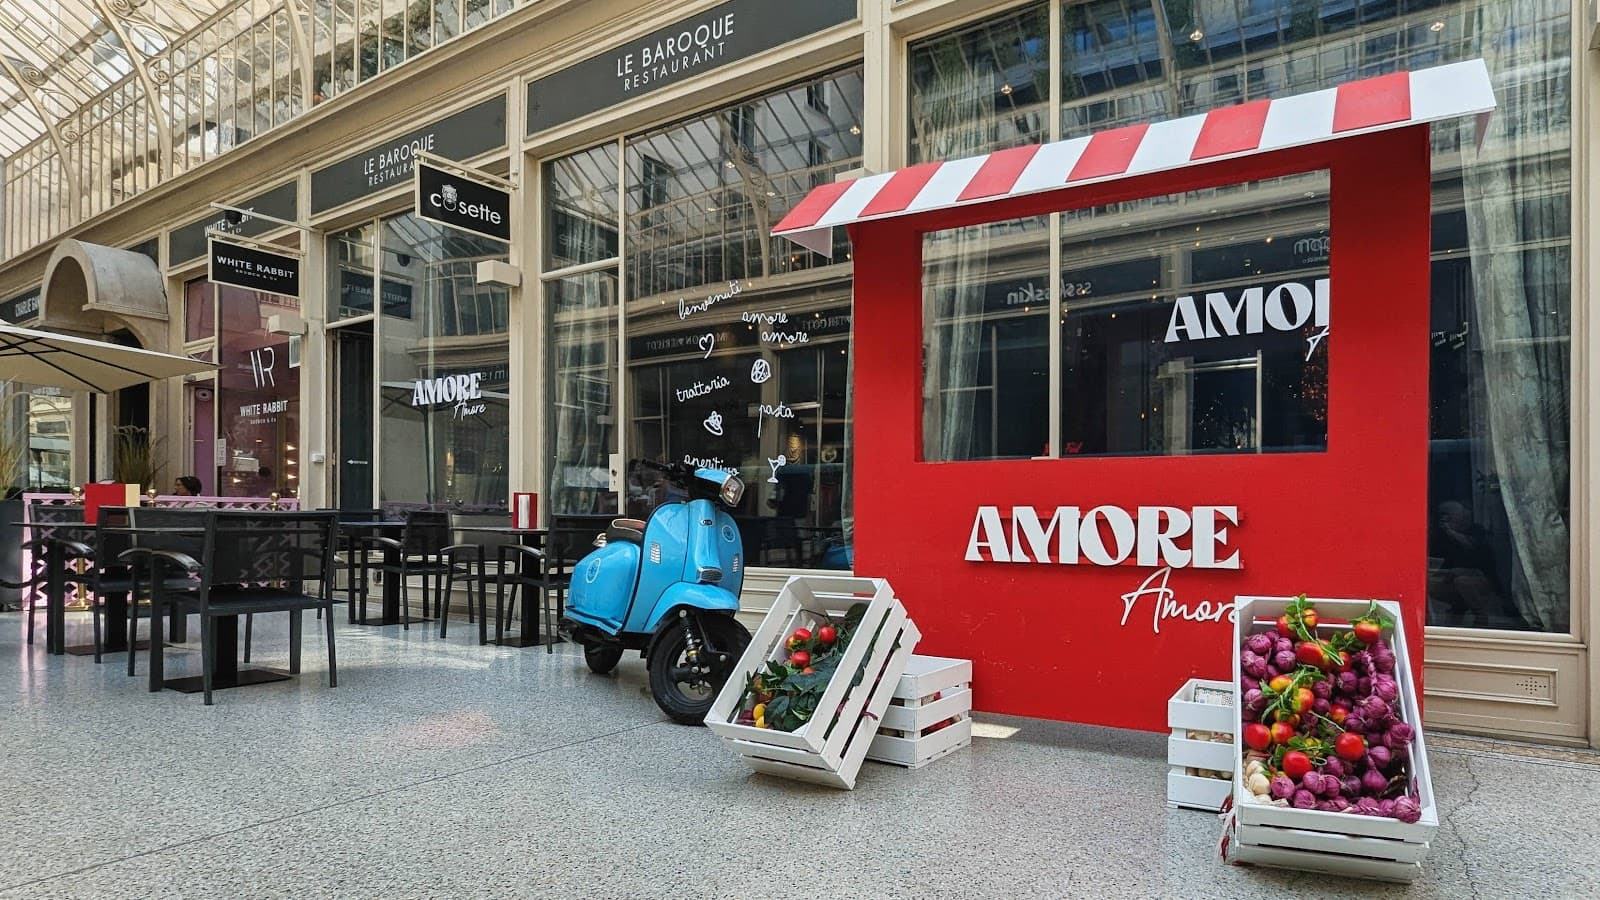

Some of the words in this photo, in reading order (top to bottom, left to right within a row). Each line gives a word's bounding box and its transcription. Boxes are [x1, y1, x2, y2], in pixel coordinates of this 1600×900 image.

[617, 54, 633, 77] LE
[642, 13, 735, 68] BAROQUE
[624, 42, 725, 91] RESTAURANT
[364, 159, 375, 176] LE
[379, 134, 435, 170] BAROQUE
[368, 158, 428, 187] RESTAURA
[216, 255, 253, 270] WHITE
[256, 264, 295, 279] RABBIT
[678, 280, 743, 319] benvenuti
[741, 311, 788, 325] amore
[761, 331, 809, 343] amore
[412, 372, 482, 406] AMORE
[676, 375, 730, 402] trattoria
[240, 403, 260, 417] WHITE
[263, 400, 288, 414] RABBIT
[453, 400, 487, 421] Amore
[758, 402, 795, 438] pasta
[964, 505, 1240, 569] AMORE
